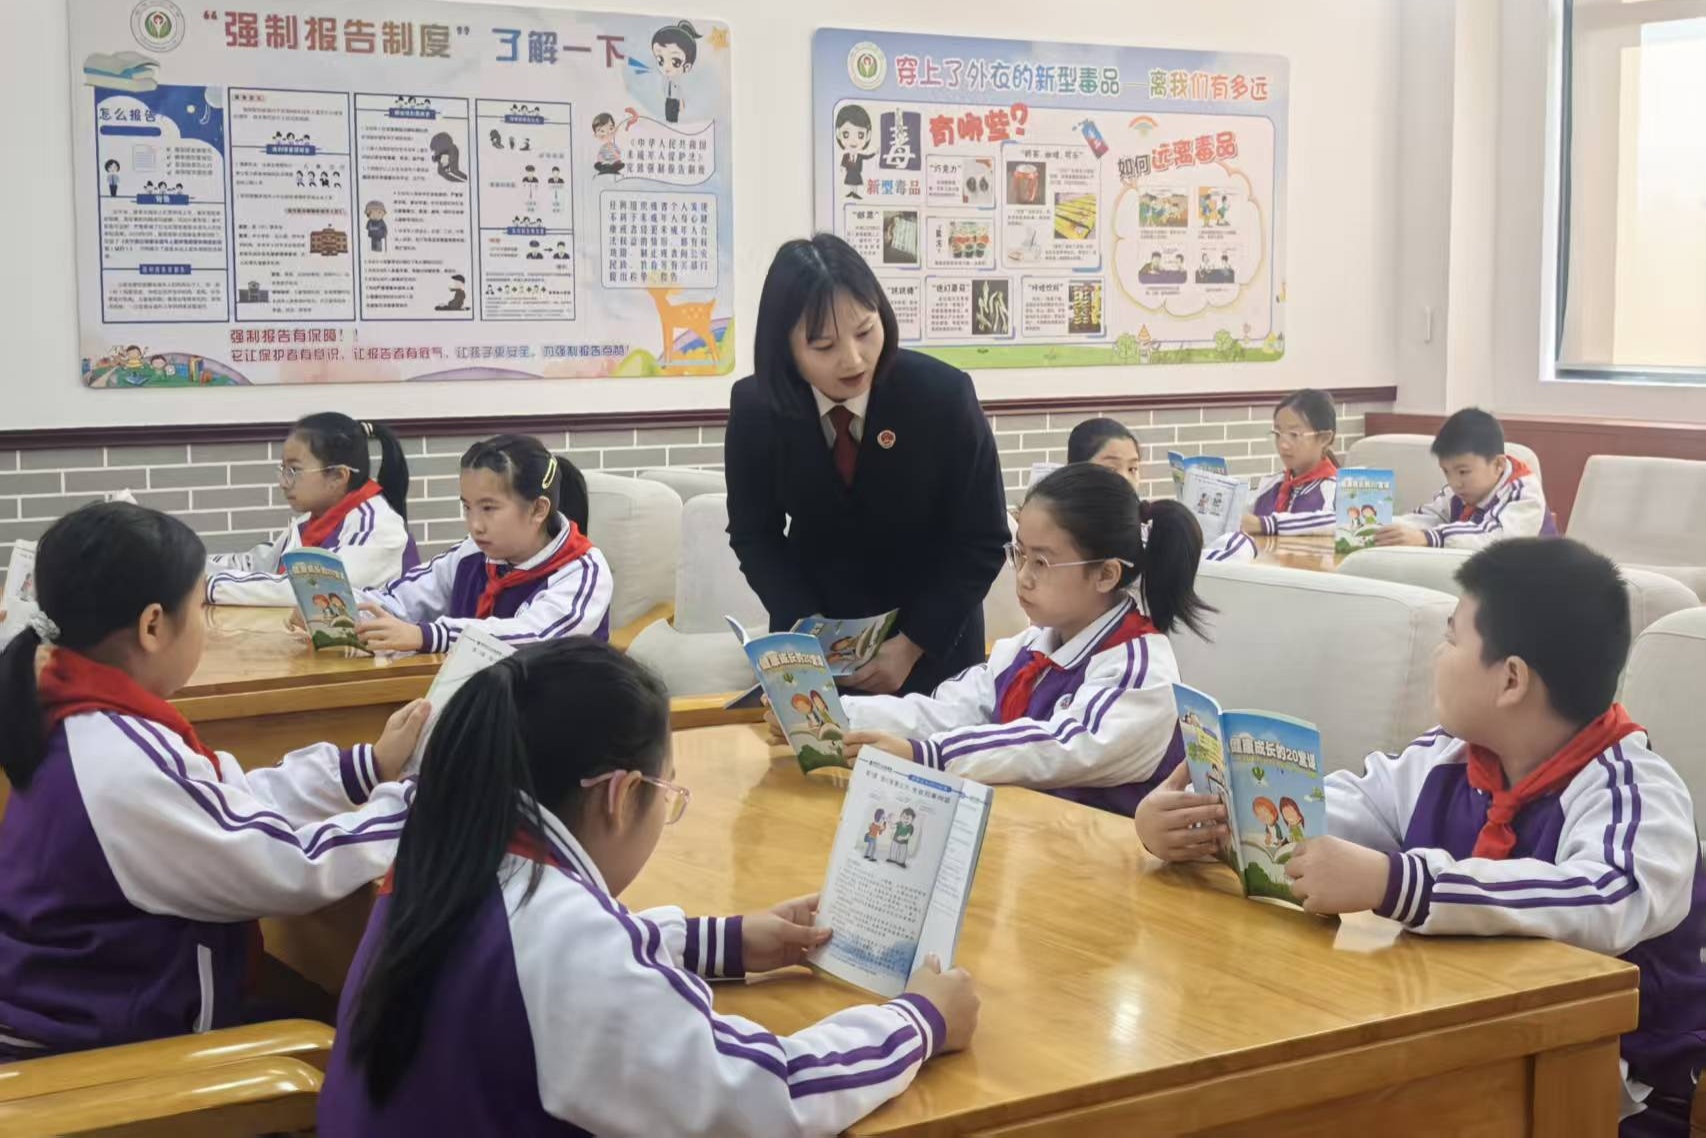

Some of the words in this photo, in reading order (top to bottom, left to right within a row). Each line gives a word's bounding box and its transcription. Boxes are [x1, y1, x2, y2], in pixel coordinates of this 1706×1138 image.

[99, 107, 156, 122] 怎么报告
[867, 178, 921, 195] 新型毒品
